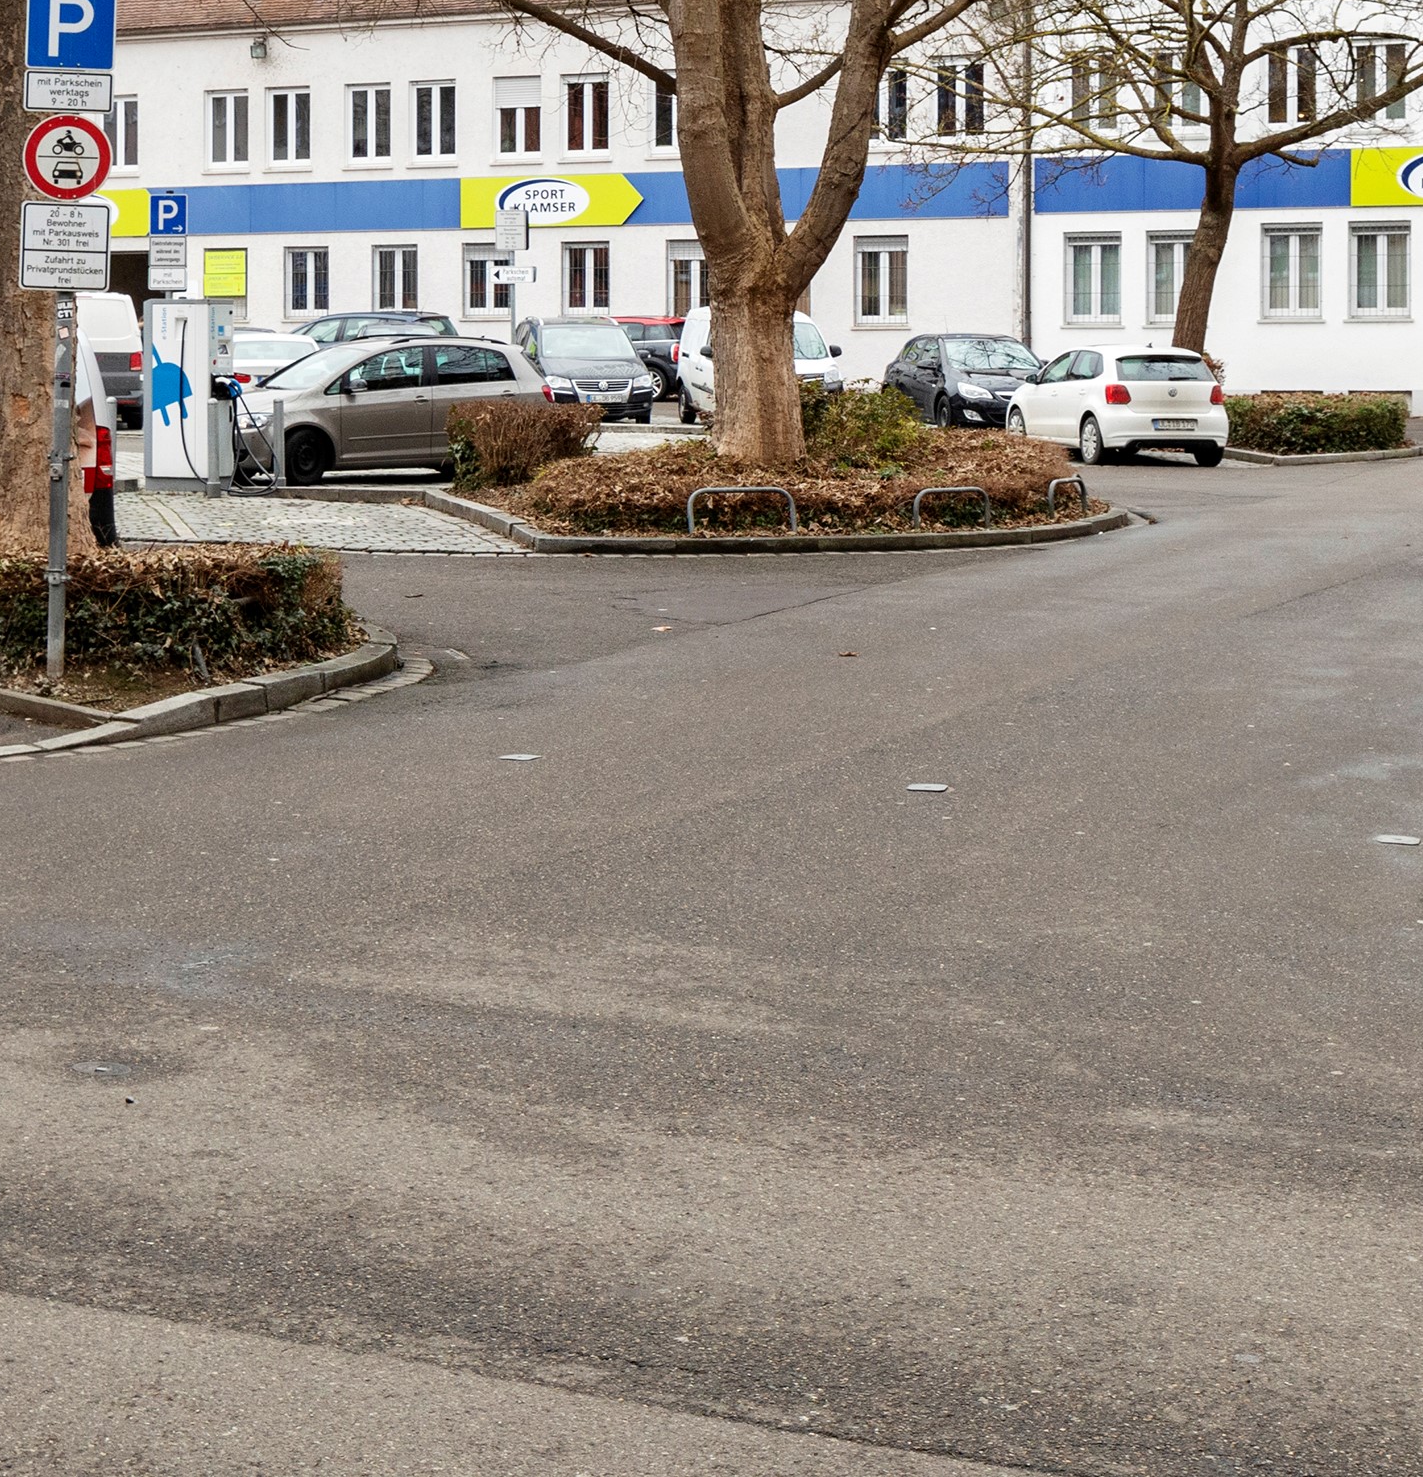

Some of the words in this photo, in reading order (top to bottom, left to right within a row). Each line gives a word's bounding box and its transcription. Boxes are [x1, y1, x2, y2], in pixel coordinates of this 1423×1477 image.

[37, 78, 51, 86] mit
[54, 78, 102, 88] Parkschein
[49, 88, 90, 98] werktags
[52, 98, 57, 106] 9
[68, 98, 78, 106] 20
[82, 98, 87, 107] h
[524, 188, 566, 200] SPORT
[50, 210, 60, 218] 20
[70, 210, 75, 218] 8
[158, 200, 178, 230] P
[46, 218, 87, 228] Bewohner
[32, 228, 46, 236] mit
[48, 228, 100, 238] Parkausweis
[42, 238, 54, 246] Nr.
[57, 238, 70, 246] 301
[76, 239, 90, 248] frei
[44, 256, 74, 264] Zufahrt
[26, 264, 104, 276] Privatgrundstücken
[502, 268, 529, 276] Parkschein
[58, 276, 72, 284] frei
